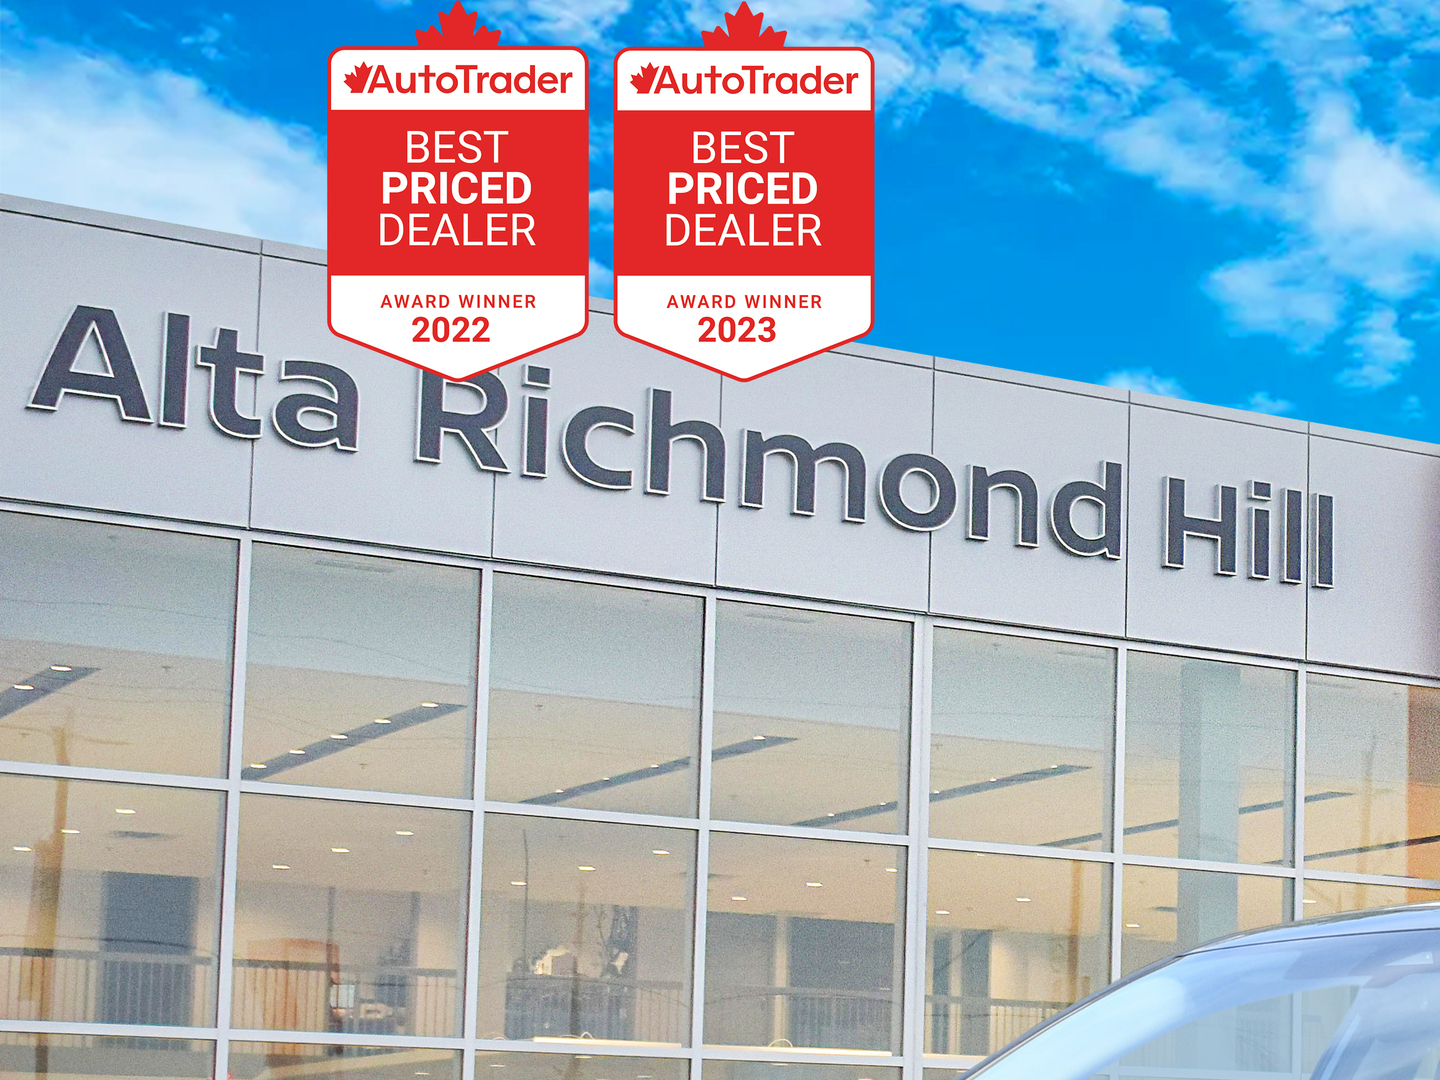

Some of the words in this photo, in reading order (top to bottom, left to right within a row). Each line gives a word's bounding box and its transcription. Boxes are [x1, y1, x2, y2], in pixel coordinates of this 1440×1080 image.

[27, 304, 360, 453] Alta
[413, 366, 1123, 561] Richmond
[1161, 476, 1335, 590] Hill
